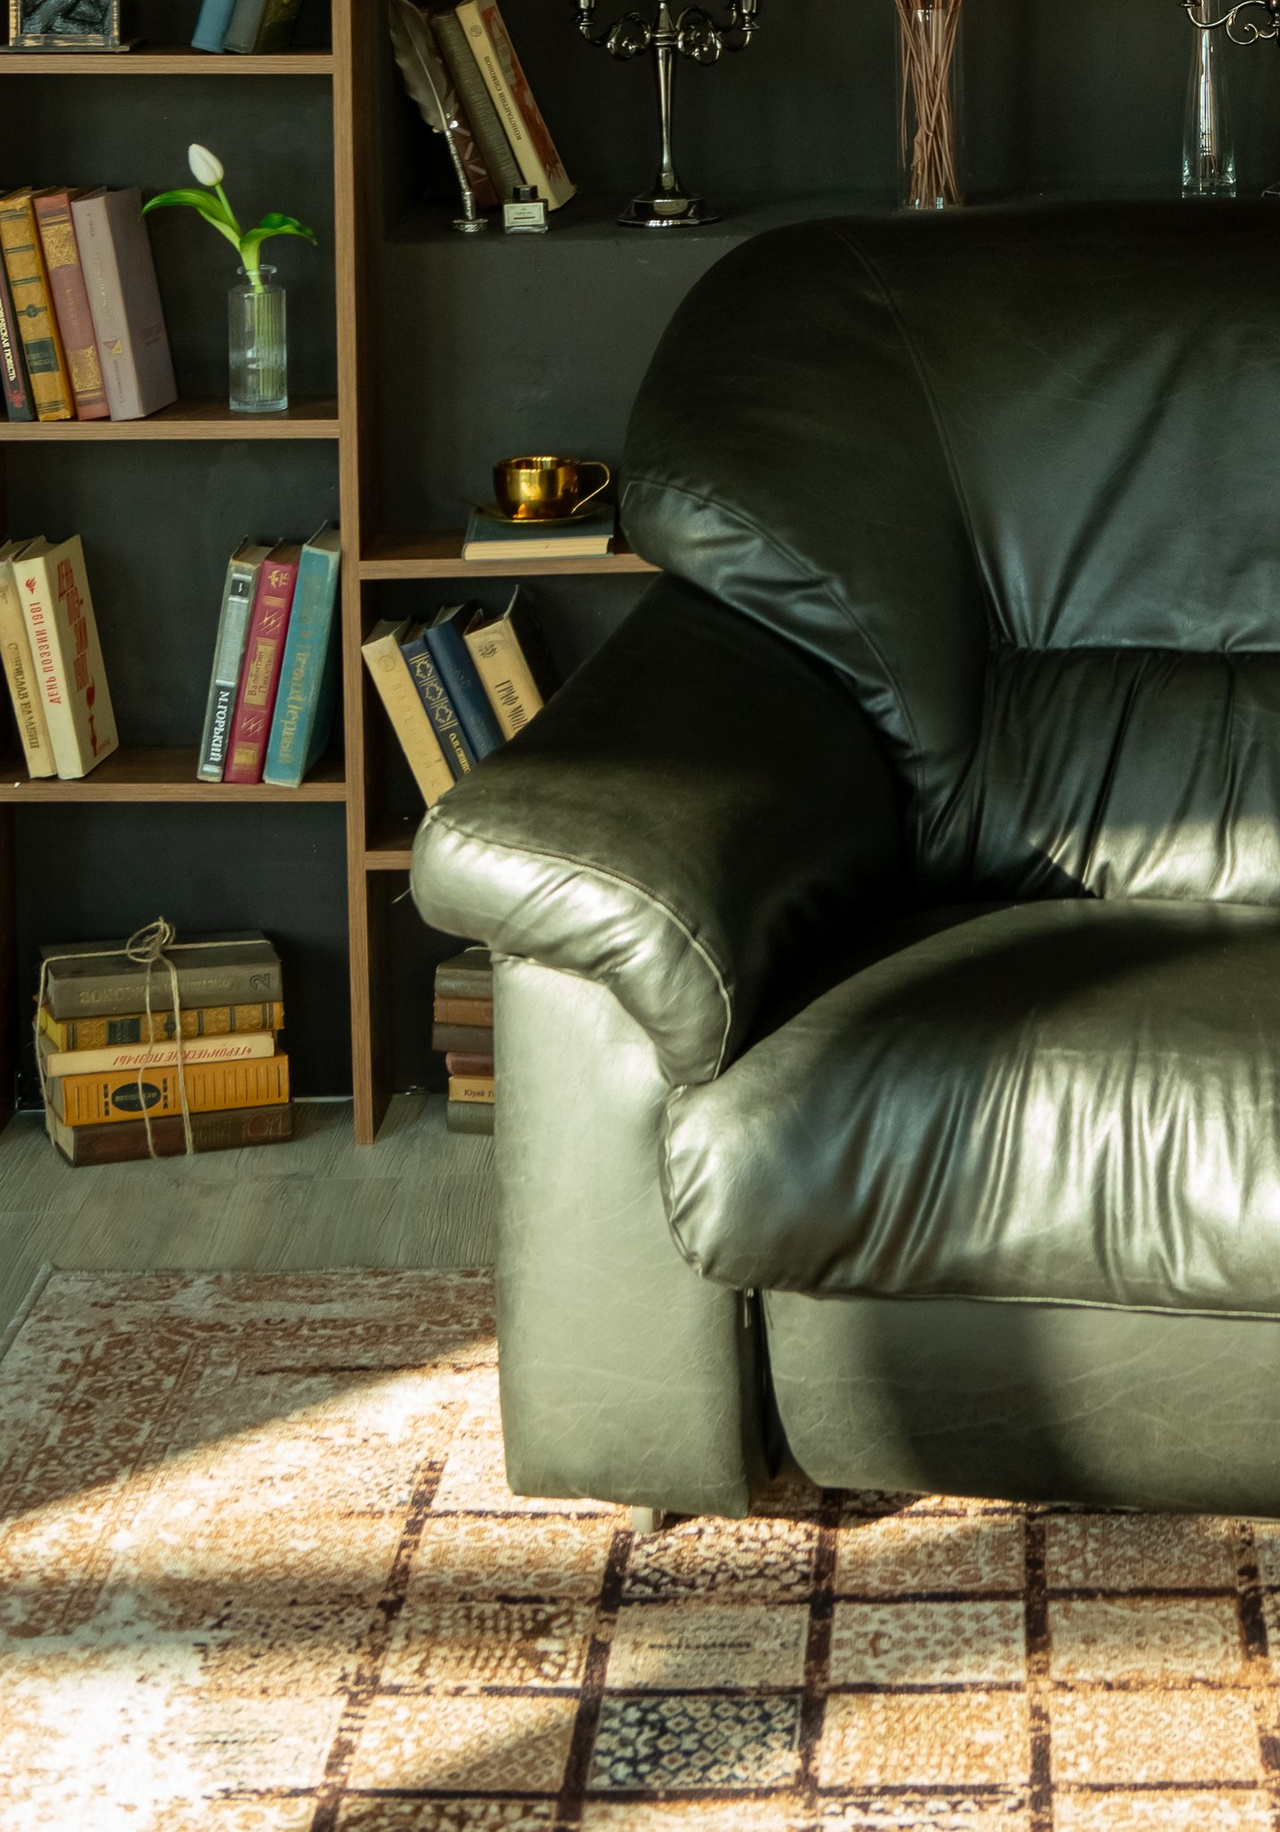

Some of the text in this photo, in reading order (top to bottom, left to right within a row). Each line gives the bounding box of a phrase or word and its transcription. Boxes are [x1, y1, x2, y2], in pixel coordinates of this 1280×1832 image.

[482, 53, 522, 141] КОНСТАНТИН СИМОНОВ
[2, 348, 16, 381] ПОВЕСТЬ
[28, 600, 63, 705] ДЕНЬ ПОЭЗИИ 1981
[247, 650, 265, 696] Валентин
[256, 656, 274, 693] Пикуль
[492, 677, 520, 709] ГРАФ
[207, 690, 231, 762] М.ГОРЬКИЙ
[113, 1044, 249, 1066] ГЕРОИЧЕСКИЕ ПОЭМЫ
